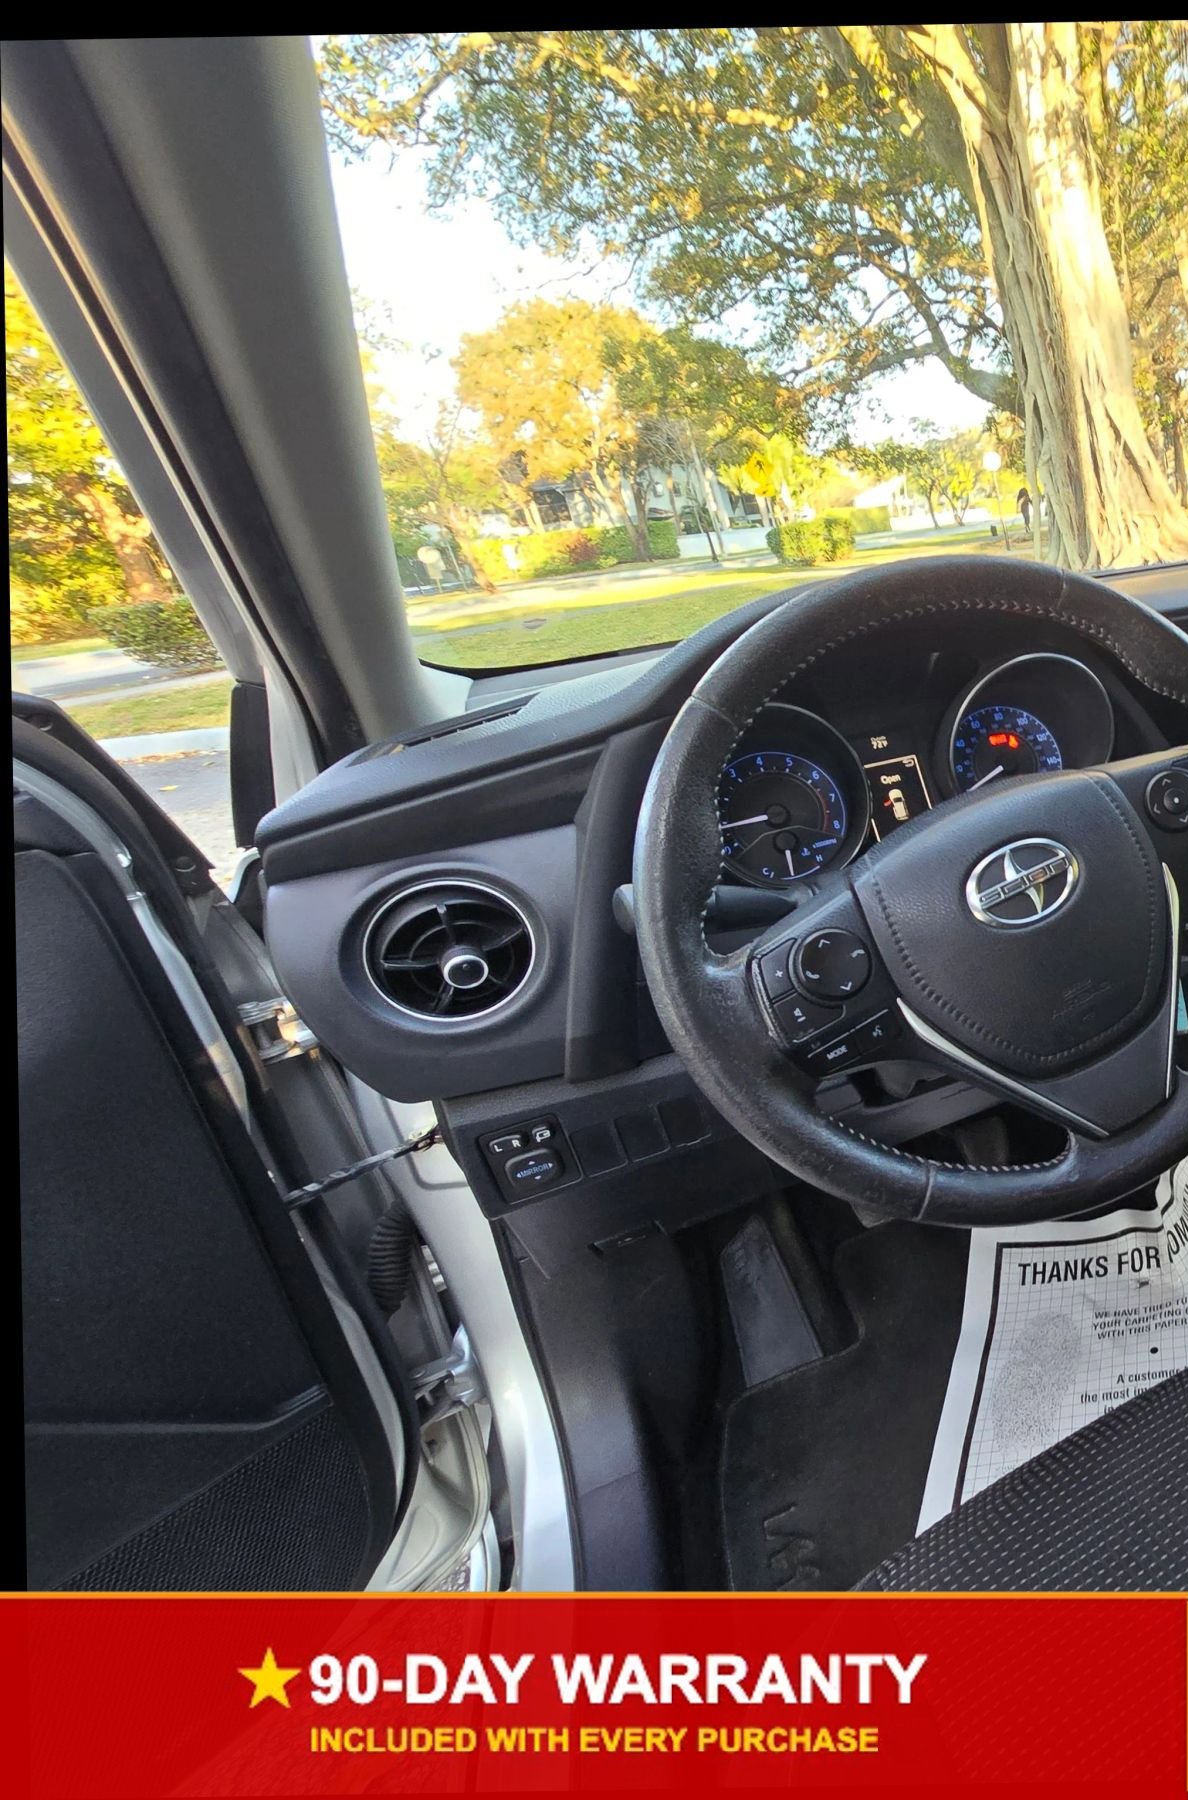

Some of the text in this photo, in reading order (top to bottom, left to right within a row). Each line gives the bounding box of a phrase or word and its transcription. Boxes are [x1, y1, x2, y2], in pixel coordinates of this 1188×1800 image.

[756, 757, 763, 765] 4
[786, 758, 792, 767] 5
[729, 769, 736, 778] 3
[812, 771, 819, 780] 6
[880, 774, 901, 784] Open
[829, 794, 835, 802] 7
[833, 820, 840, 829] 8
[816, 854, 823, 862] H
[763, 867, 769, 875] C
[980, 857, 1069, 910] SCION
[826, 1045, 848, 1060] MODE
[494, 1139, 520, 1152] L R
[520, 1162, 548, 1177] MIRROR
[1018, 1256, 1108, 1286] THANKS
[1117, 1246, 1161, 1275] FOR
[1094, 1311, 1111, 1319] WE
[1113, 1308, 1140, 1317] HAVE
[1144, 1301, 1172, 1314] TRIED
[1176, 1296, 1188, 1306] TO
[1093, 1318, 1121, 1331] YOUR
[1125, 1308, 1182, 1327] CARPETING
[1097, 1329, 1125, 1340] WITH
[1129, 1325, 1151, 1335] THIS
[1155, 1316, 1188, 1330] PAPER
[1116, 1373, 1125, 1384] A
[1080, 1391, 1098, 1404] the
[1102, 1387, 1130, 1401] most
